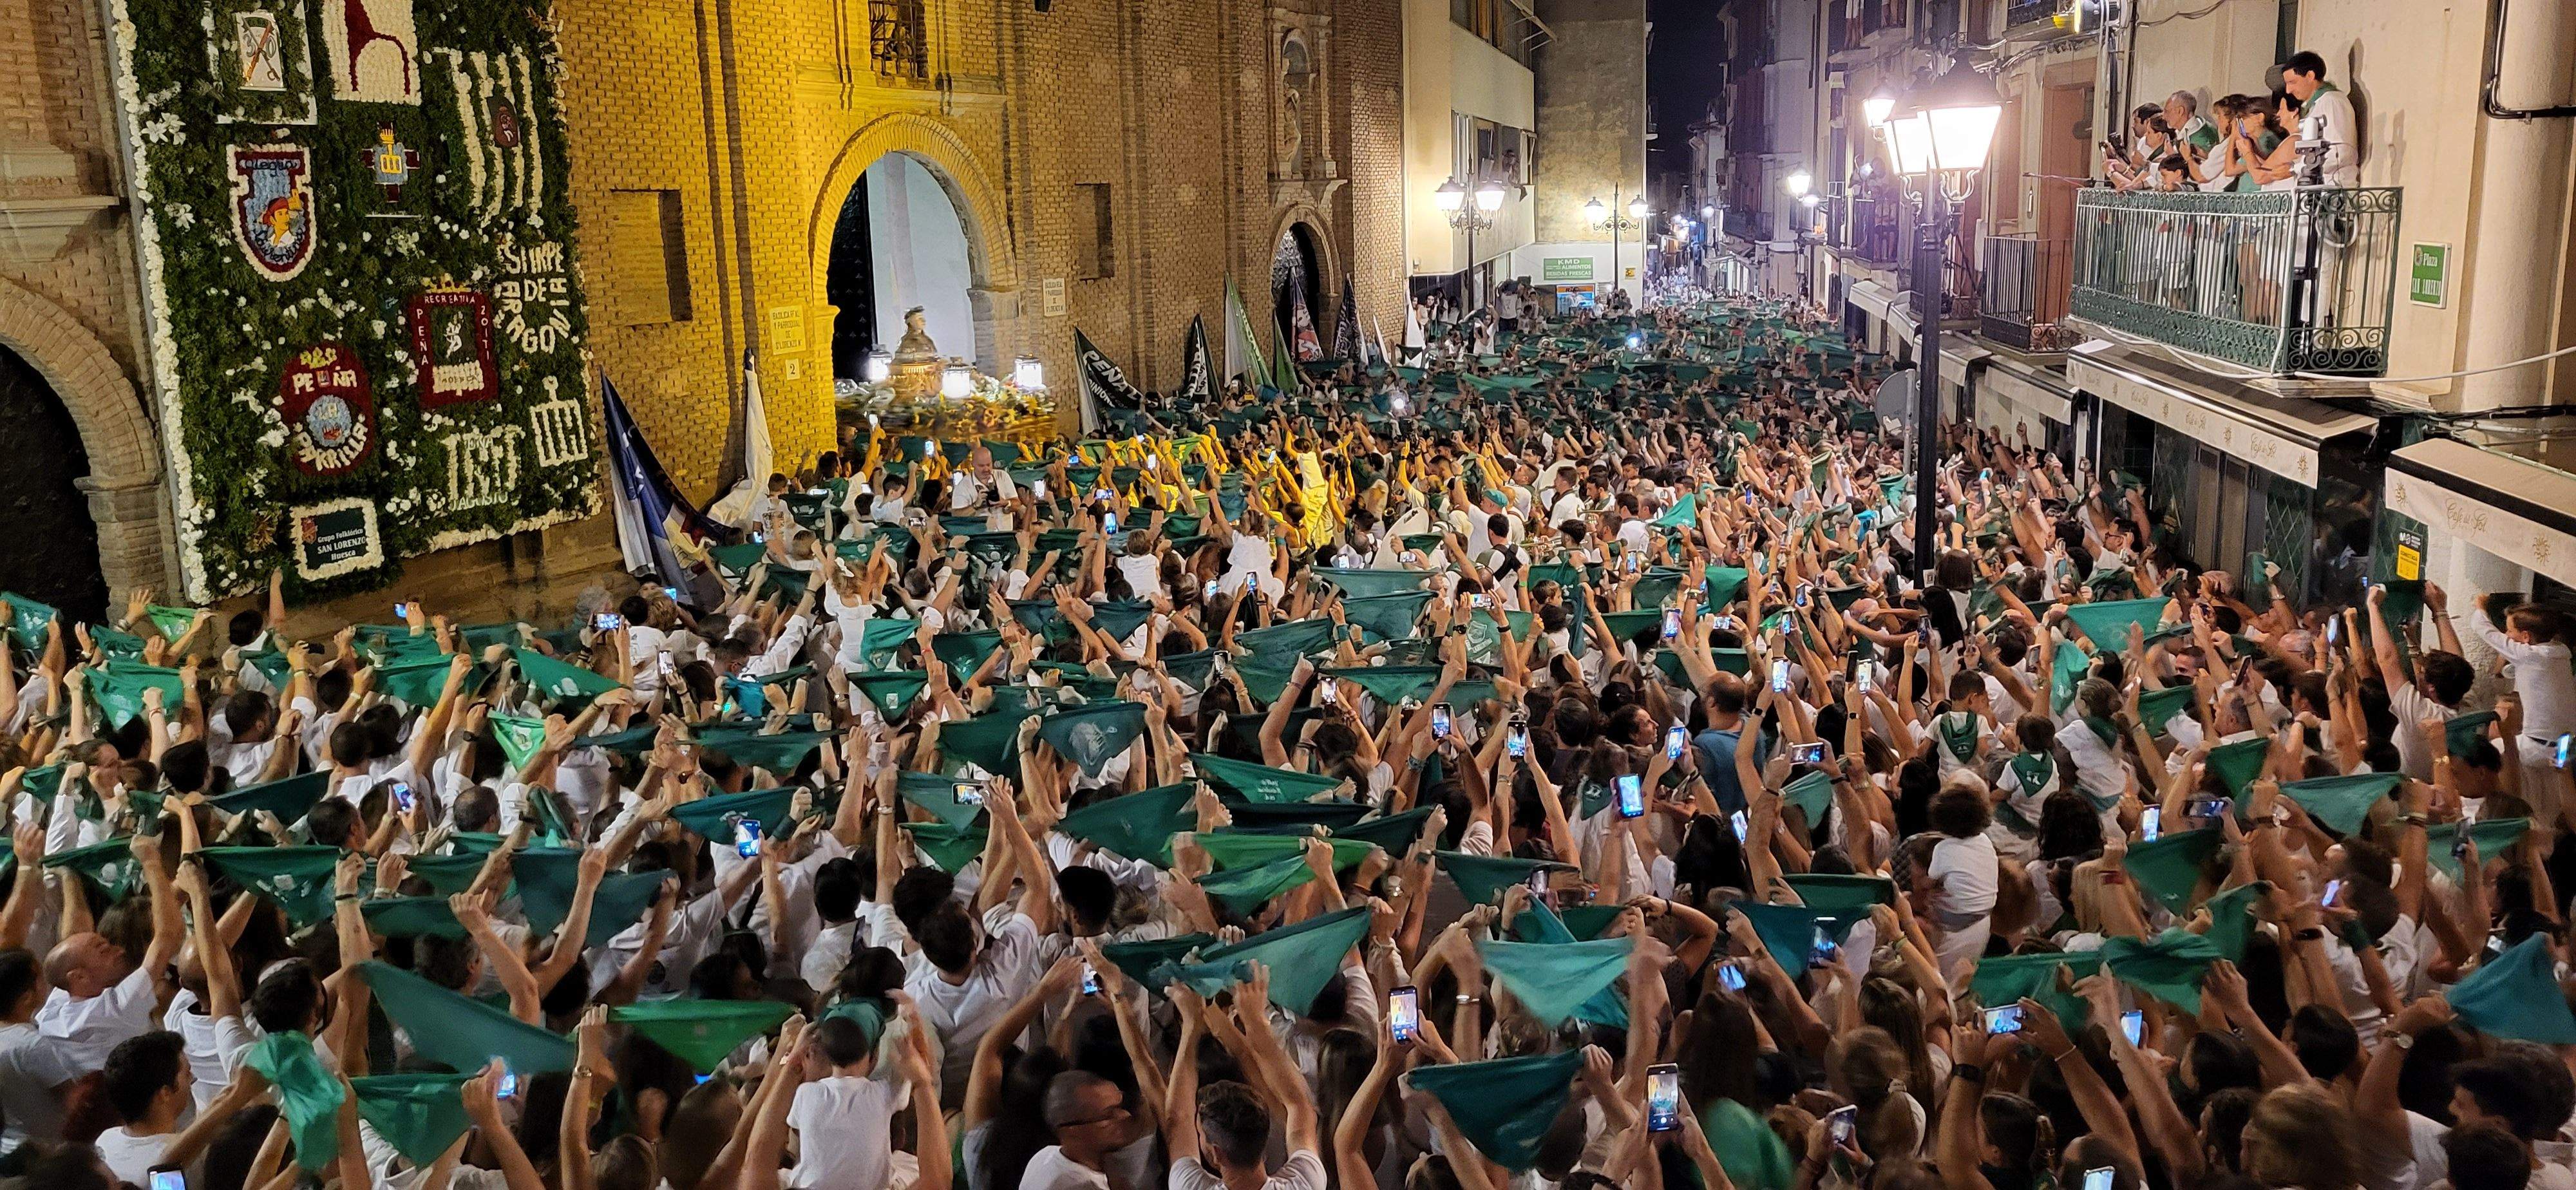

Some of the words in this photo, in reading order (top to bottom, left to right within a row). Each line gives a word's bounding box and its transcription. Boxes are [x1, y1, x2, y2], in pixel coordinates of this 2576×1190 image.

[524, 278, 547, 302] DE
[790, 363, 795, 375] 2
[292, 365, 357, 395] PEÑA
[317, 543, 333, 554] SAN
[334, 536, 366, 551] LORENZO
[331, 550, 356, 560] Huesca
